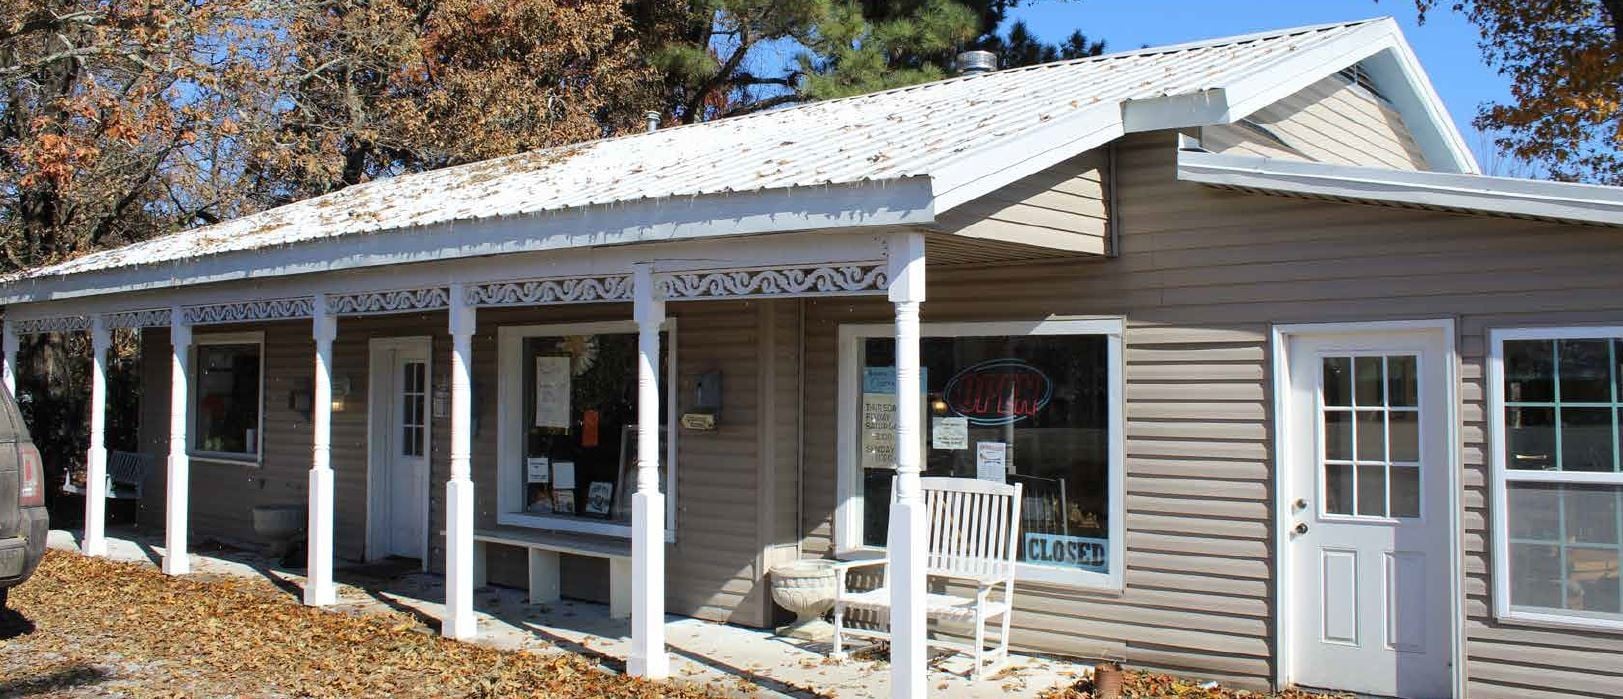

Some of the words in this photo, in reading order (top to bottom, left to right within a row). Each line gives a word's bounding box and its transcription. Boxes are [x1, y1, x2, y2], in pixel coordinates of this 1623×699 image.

[954, 372, 1042, 416] OPEN
[865, 403, 897, 412] THURSDA
[865, 421, 897, 430] SATURDA
[1028, 537, 1105, 567] CLOSED
